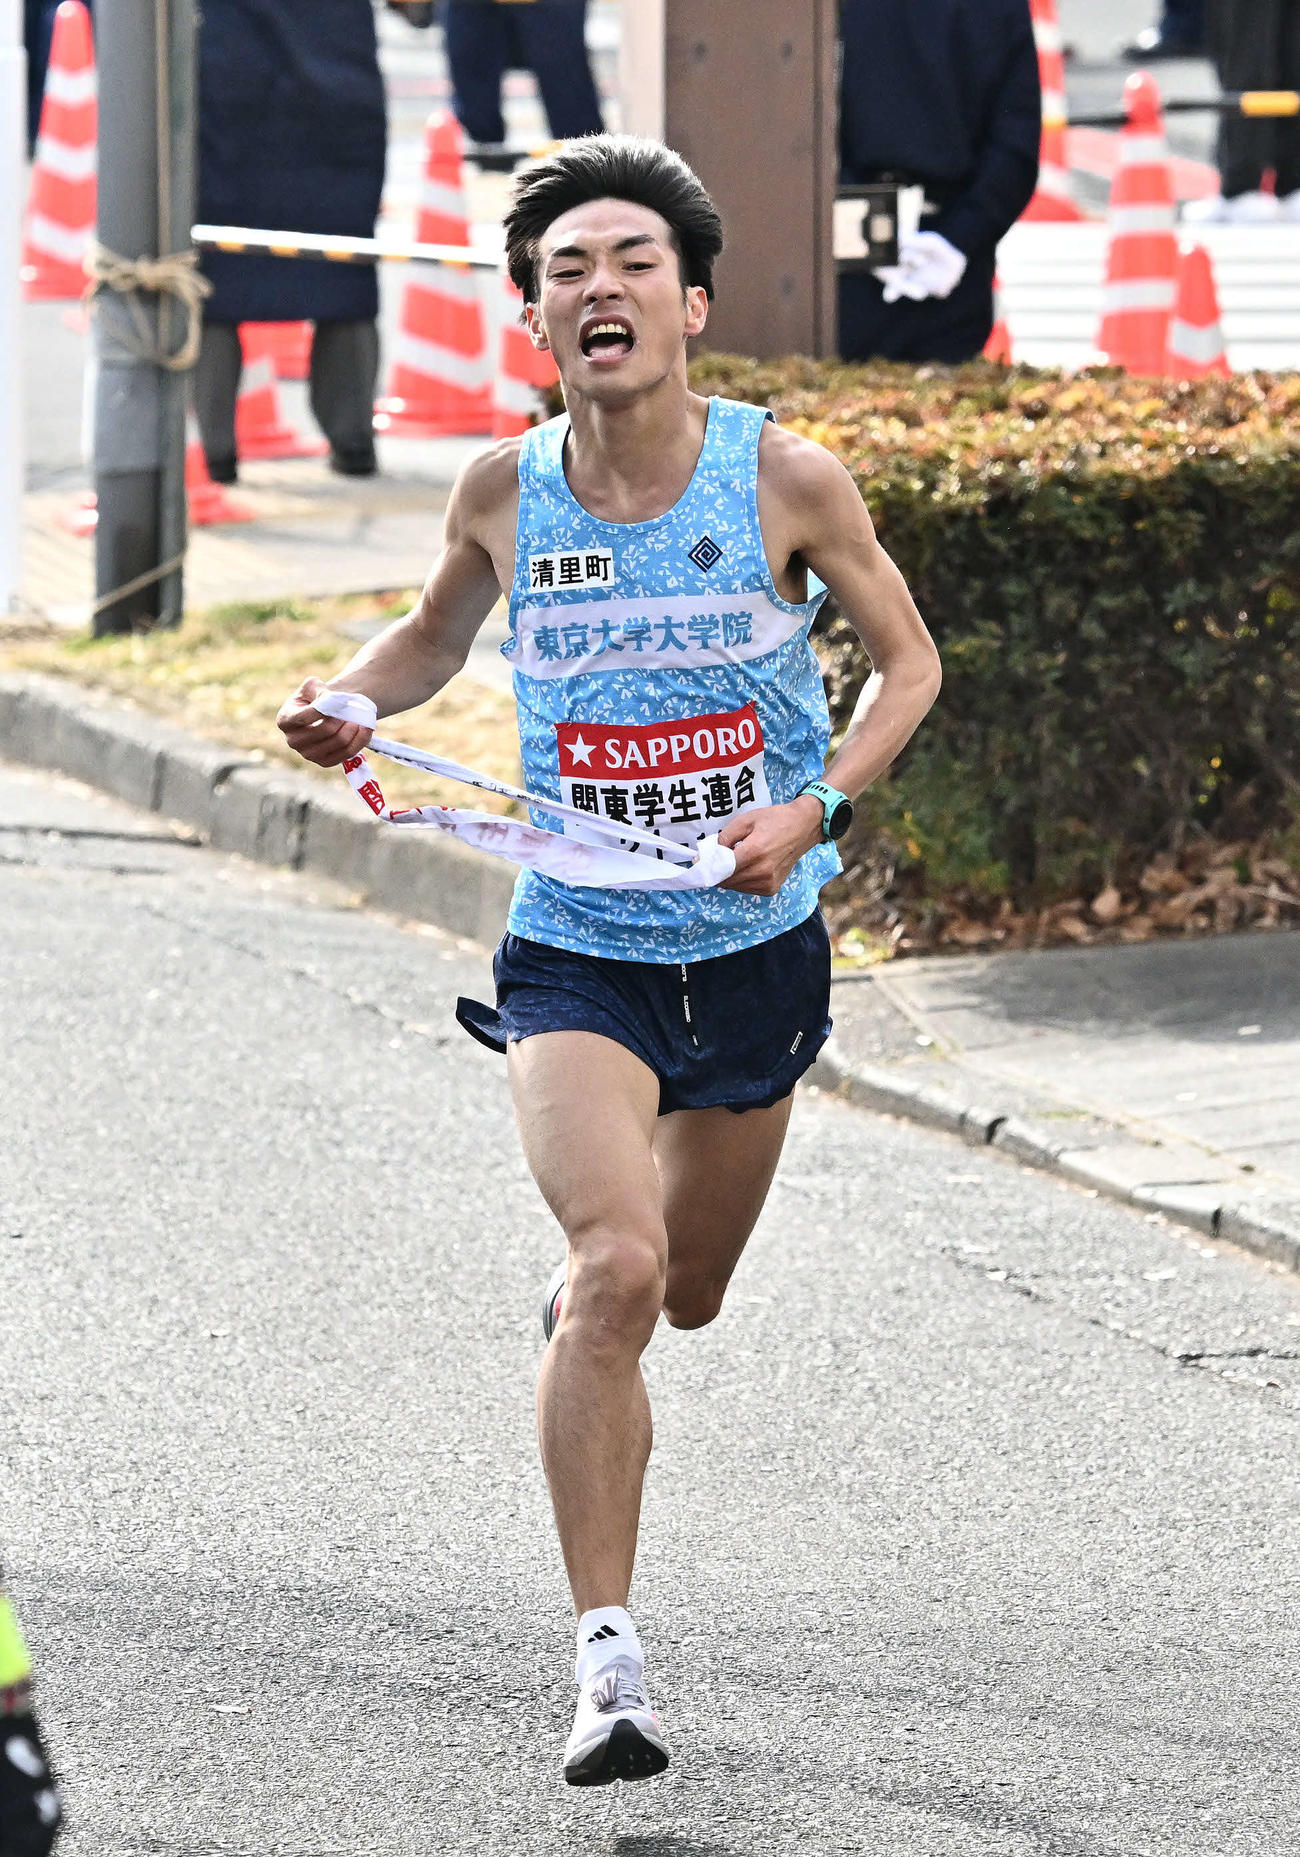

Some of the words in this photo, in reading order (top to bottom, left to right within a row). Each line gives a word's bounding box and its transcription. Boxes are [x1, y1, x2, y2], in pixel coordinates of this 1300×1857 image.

[531, 555, 611, 588] 清里町
[533, 610, 752, 661] 東京大学大学院
[604, 718, 756, 769] SAPPORO
[571, 765, 756, 827] 関東学生連合
